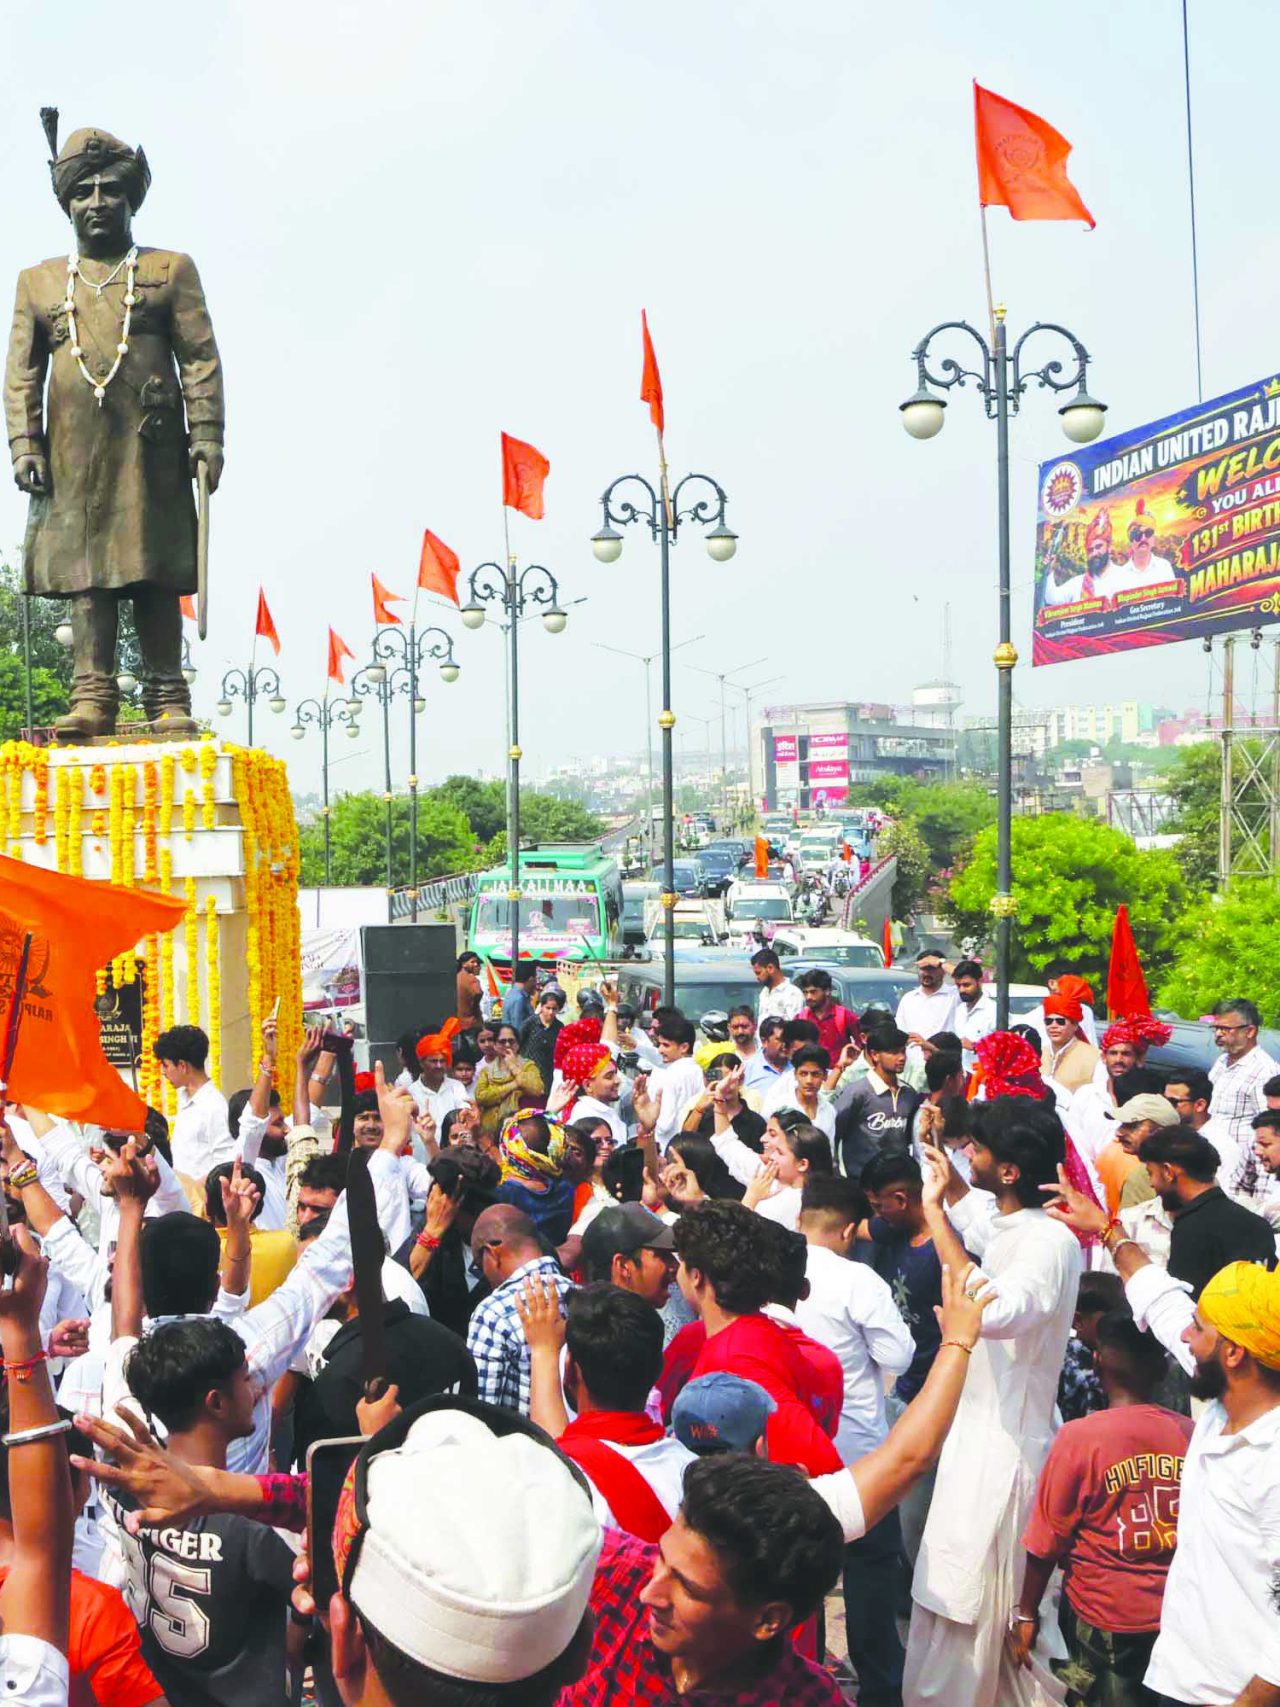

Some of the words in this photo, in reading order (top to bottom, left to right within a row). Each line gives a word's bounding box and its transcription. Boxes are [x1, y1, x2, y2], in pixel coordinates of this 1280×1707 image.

[1093, 446, 1153, 493] INDIAN
[1157, 419, 1228, 468] UNITED
[1197, 437, 1280, 500] WELC
[1211, 489, 1247, 513] YOU
[554, 880, 586, 893] MAA
[1105, 1453, 1185, 1494] HILFIGE
